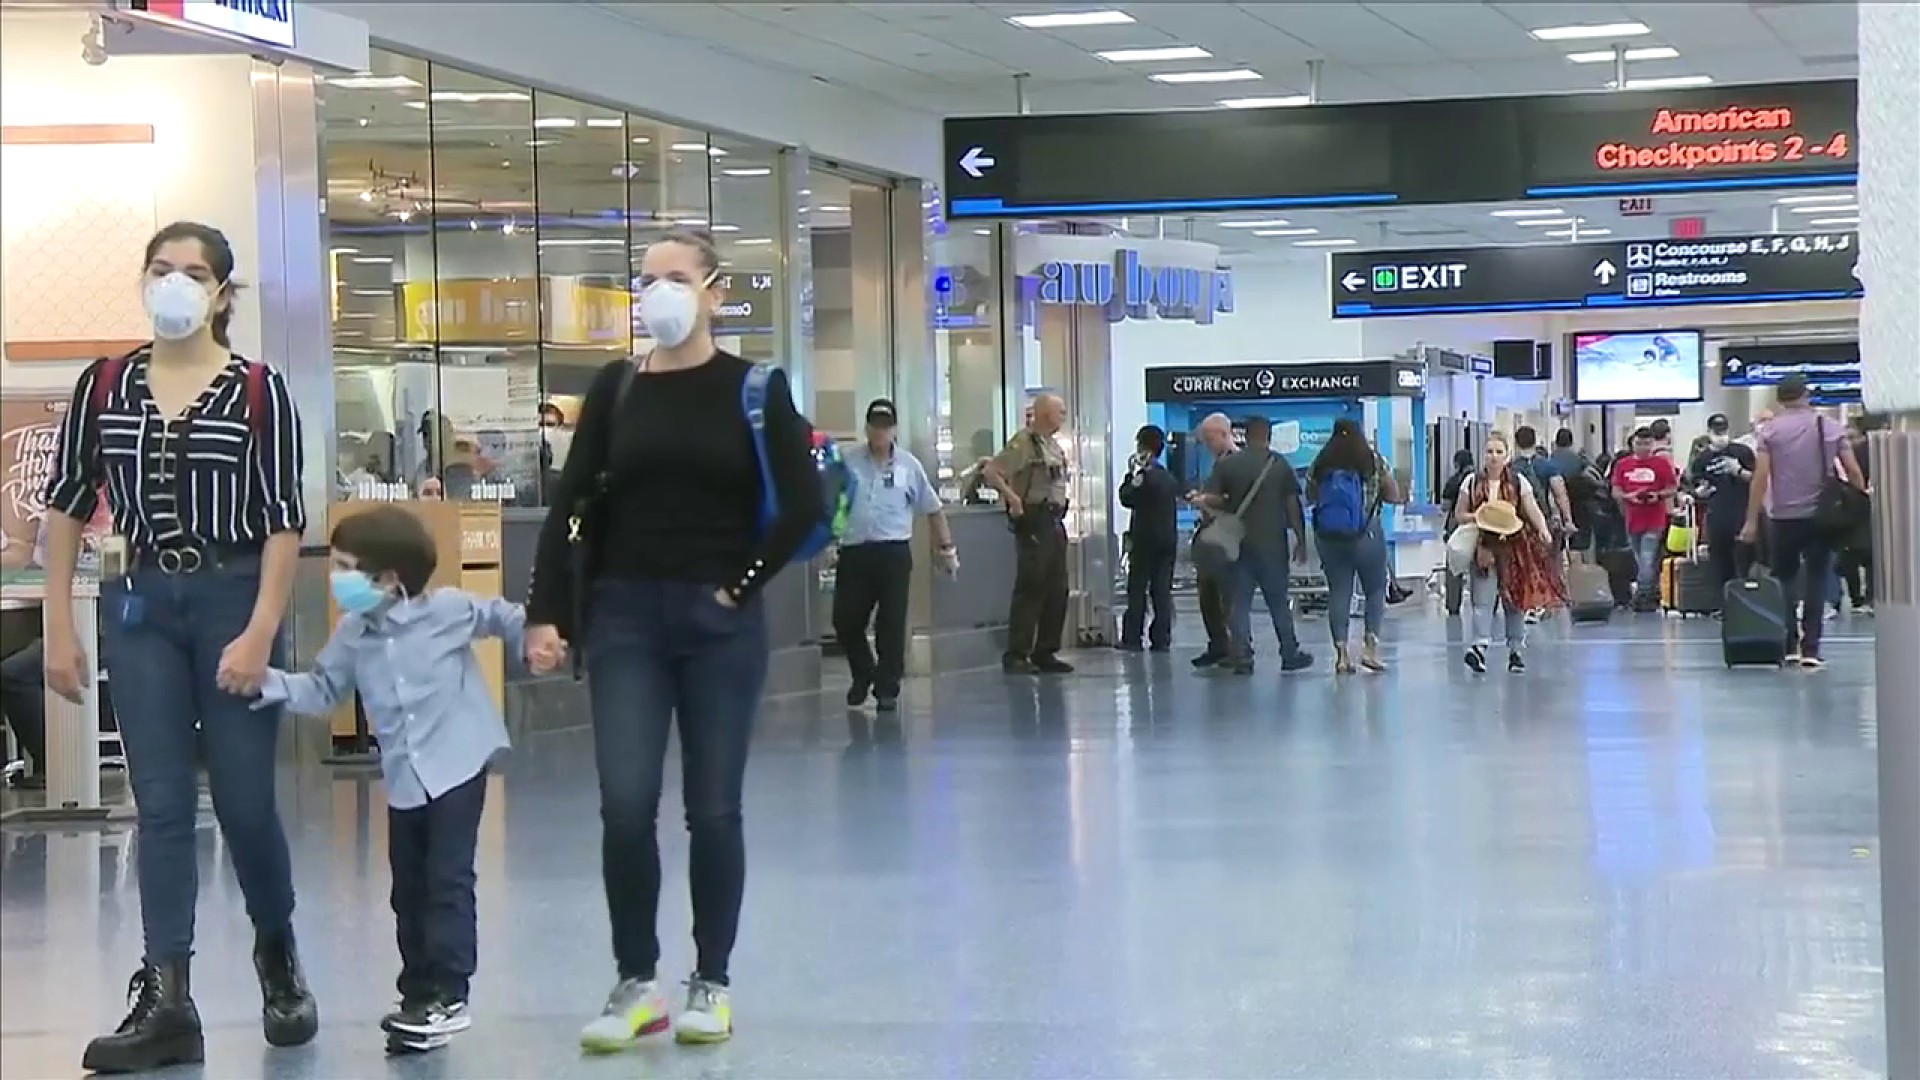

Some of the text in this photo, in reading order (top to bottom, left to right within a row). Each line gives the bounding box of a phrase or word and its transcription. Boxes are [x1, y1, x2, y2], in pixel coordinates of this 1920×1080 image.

[1653, 106, 1791, 133] American
[1597, 139, 1777, 170] Checkpoints
[1784, 135, 1804, 161] 2
[1826, 134, 1848, 158] 4
[1619, 198, 1652, 211] EXIT
[1655, 242, 1747, 257] Concourse
[1750, 239, 1768, 255] E,
[1771, 239, 1787, 254] F,
[1814, 236, 1834, 252] H,
[1836, 234, 1849, 249] J
[1041, 262, 1114, 305] au
[1401, 264, 1468, 289] EXIT
[1655, 271, 1747, 288] Restrooms
[1173, 375, 1361, 393] CURRENCY EXCHANGE
